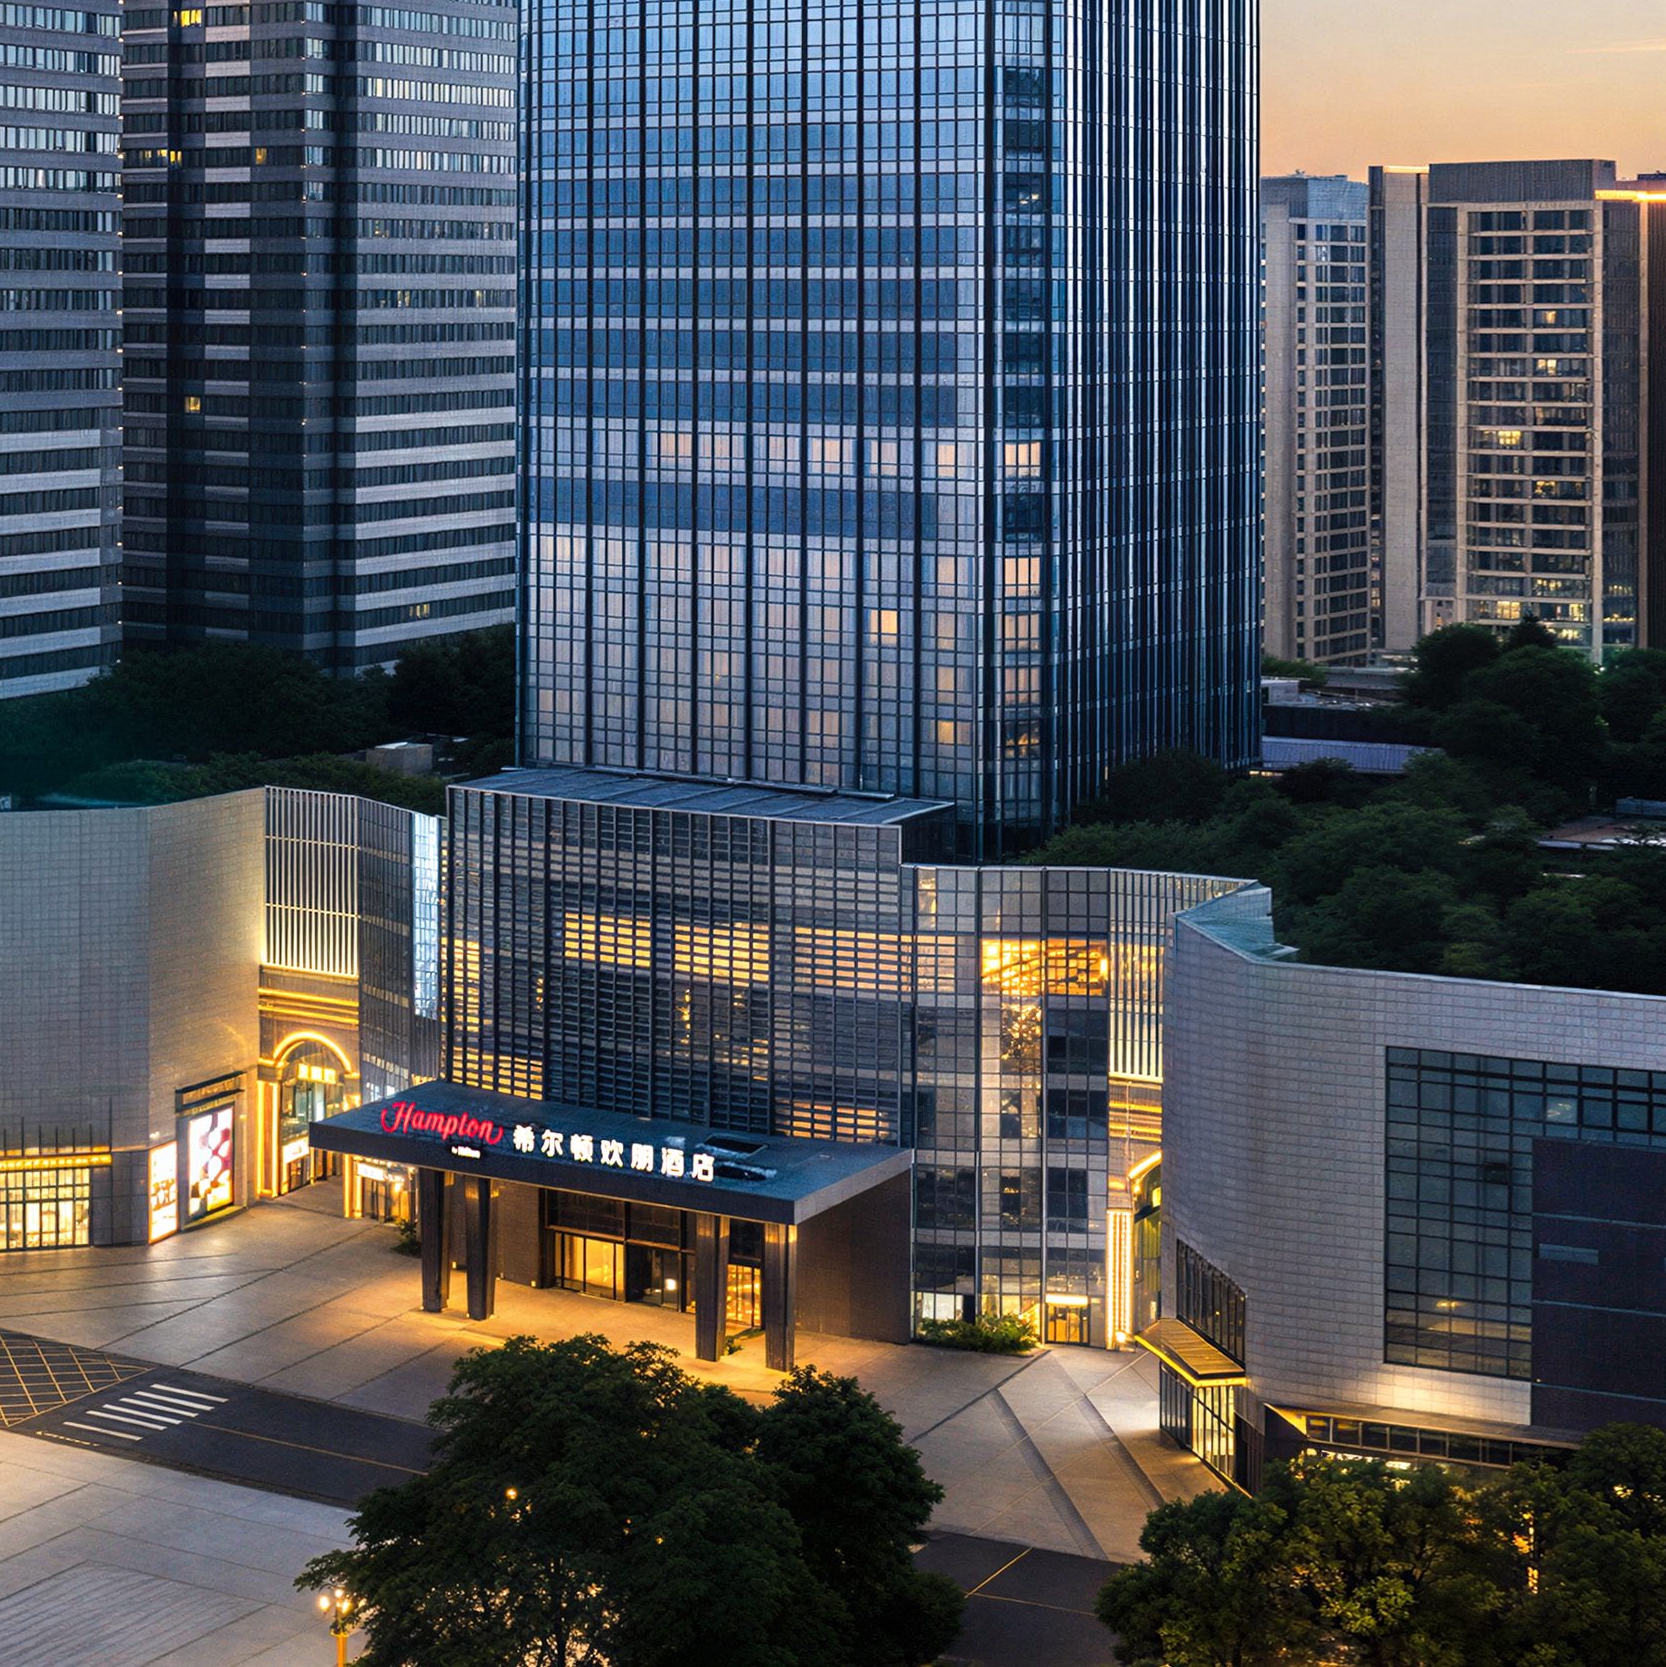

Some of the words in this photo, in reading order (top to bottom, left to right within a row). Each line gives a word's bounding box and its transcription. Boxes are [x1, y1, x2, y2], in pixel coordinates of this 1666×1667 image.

[380, 1100, 504, 1145] Hampton
[512, 1124, 715, 1182] 希尔顿欢朋酒店
